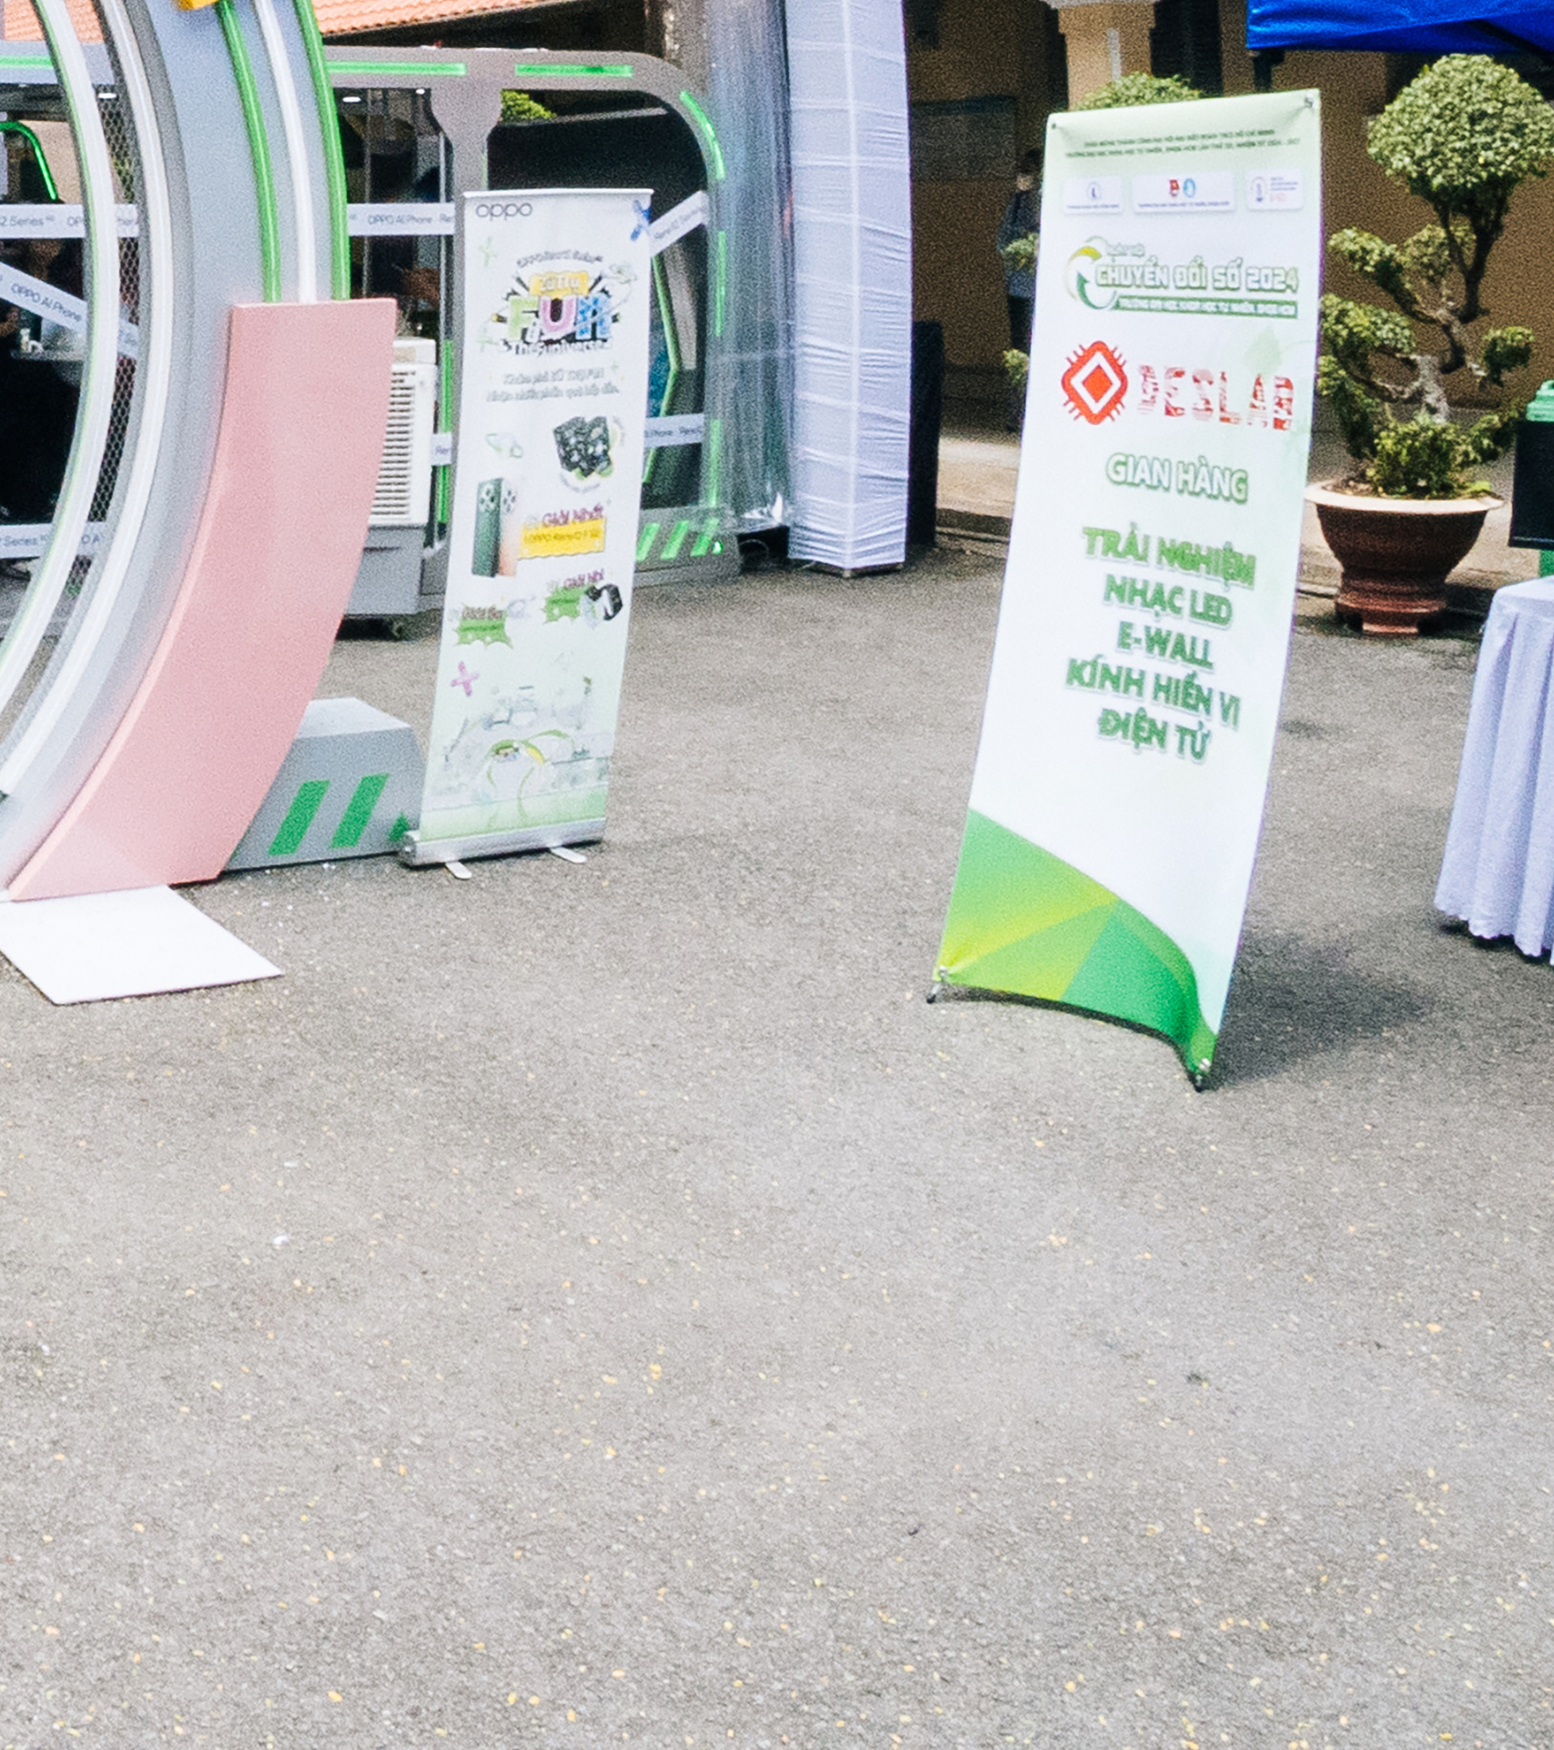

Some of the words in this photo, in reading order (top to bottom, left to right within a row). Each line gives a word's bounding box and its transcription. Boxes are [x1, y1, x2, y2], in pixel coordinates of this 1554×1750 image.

[475, 202, 533, 221] oppo
[1245, 266, 1300, 294] 2024
[1105, 451, 1172, 492] GIAN
[1176, 454, 1249, 504] HÀNG
[1082, 521, 1151, 564] TRẢI
[1157, 540, 1257, 590] NGHIỆM
[1103, 573, 1184, 621] NHẠC
[1189, 588, 1233, 630] LED
[1116, 620, 1215, 673] E-WALL
[1065, 653, 1147, 698] KÍNH
[1219, 690, 1243, 731] VI
[1097, 706, 1169, 754] ĐIỆN
